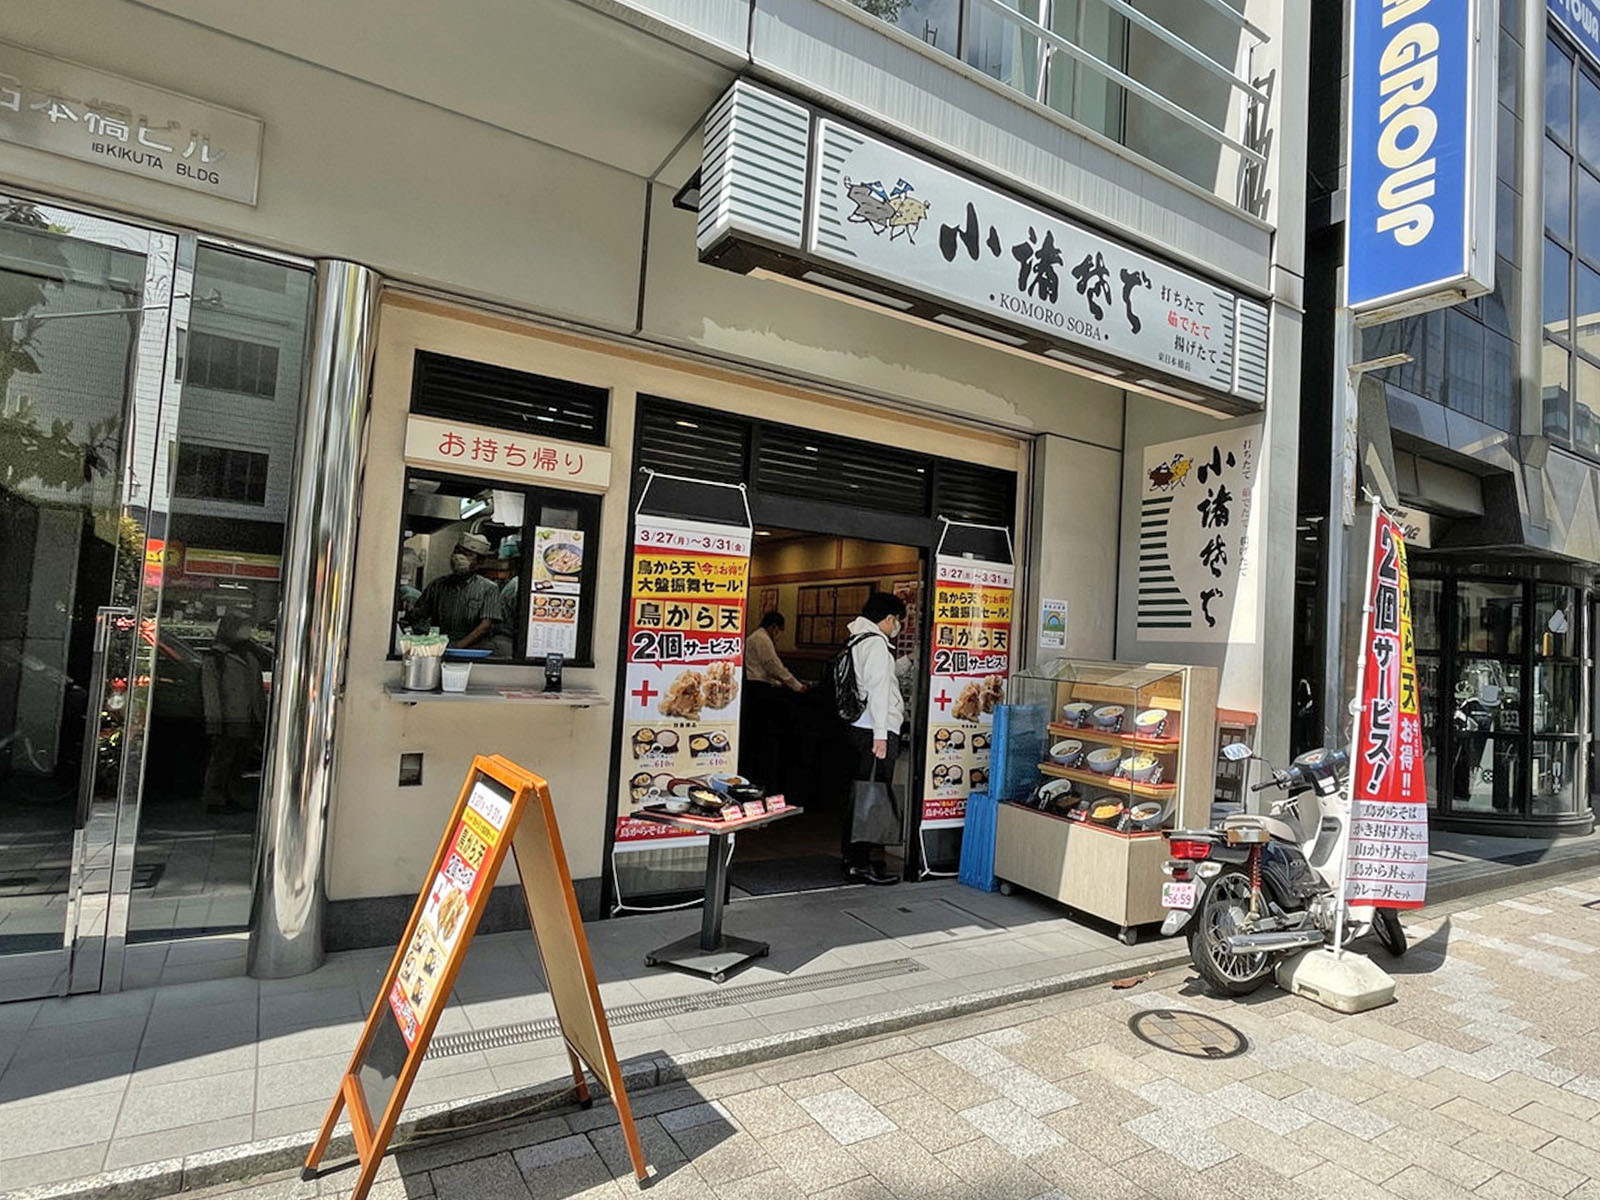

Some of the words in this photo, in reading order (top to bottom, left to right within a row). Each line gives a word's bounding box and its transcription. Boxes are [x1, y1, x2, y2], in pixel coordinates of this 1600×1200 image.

[176, 162, 220, 184] BLDG
[1161, 284, 1206, 316] 打ちたて
[999, 292, 1066, 328] KOMORO
[1066, 318, 1102, 341] SOBA
[1167, 309, 1211, 340] 茹でたて
[1174, 334, 1217, 364] 揚げたて
[438, 431, 584, 475] お持ち帰り
[637, 602, 740, 631] 鳥から天
[937, 626, 1008, 650] 鳥から天
[1365, 524, 1399, 794] 2個サービス!
[1363, 804, 1417, 820] 鳥からそば
